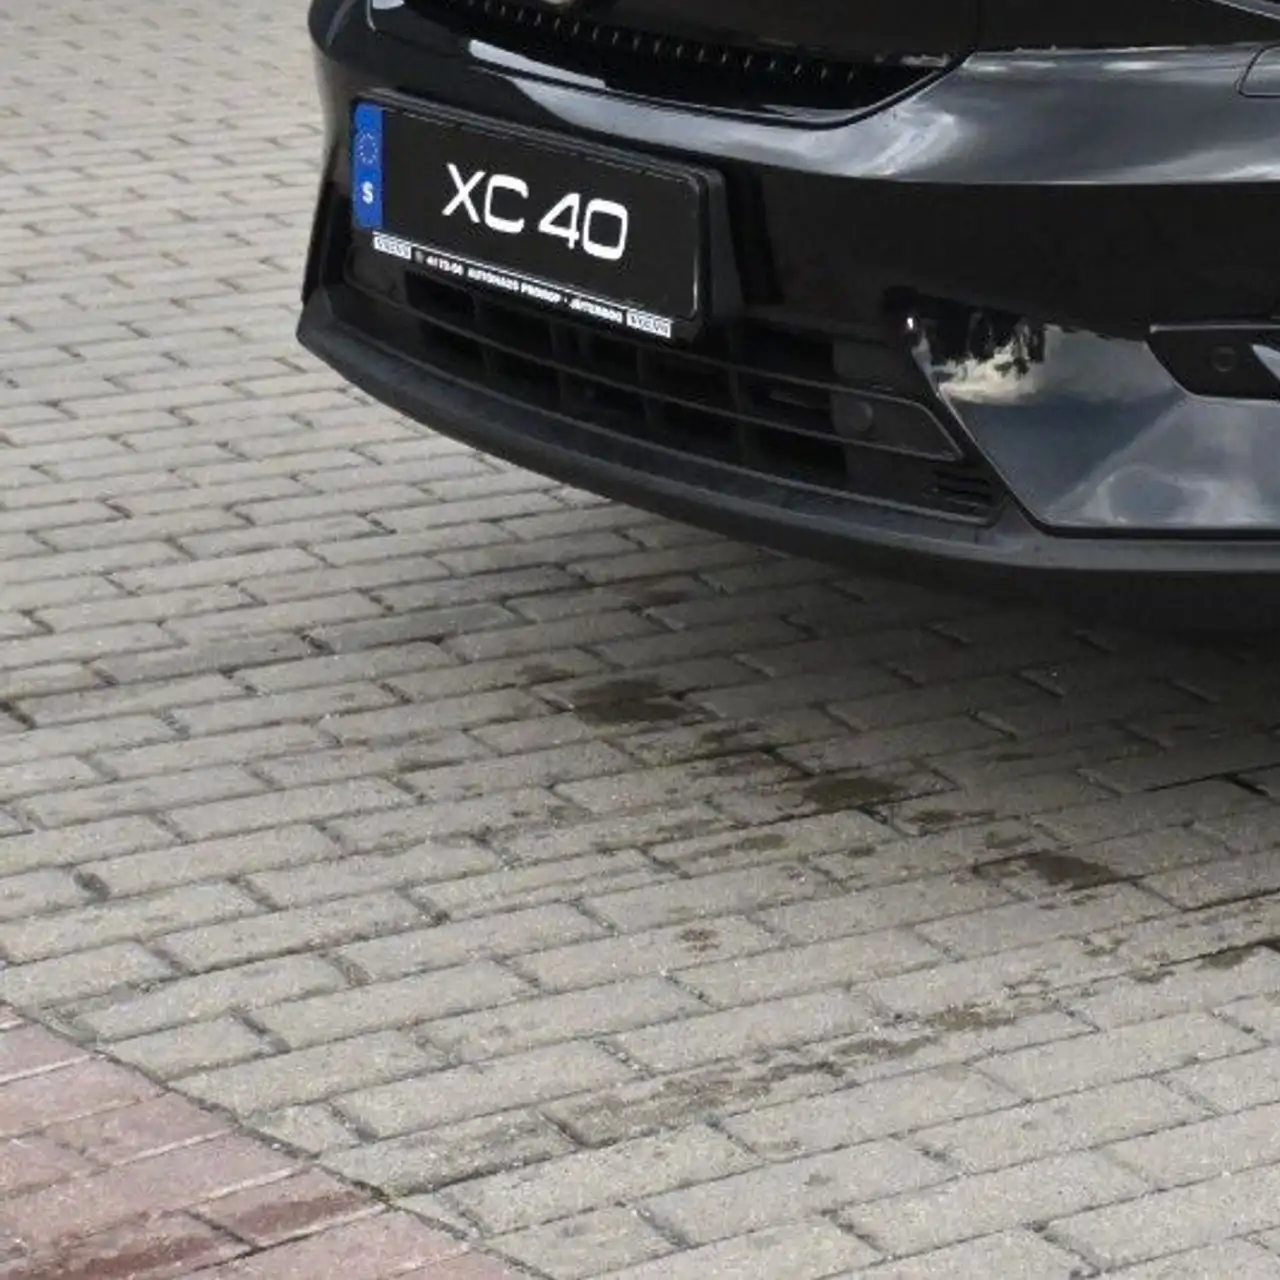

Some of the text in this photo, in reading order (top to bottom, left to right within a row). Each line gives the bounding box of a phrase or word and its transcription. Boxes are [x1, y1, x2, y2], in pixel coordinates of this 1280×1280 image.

[362, 180, 374, 205] S
[441, 162, 629, 260] XC 40
